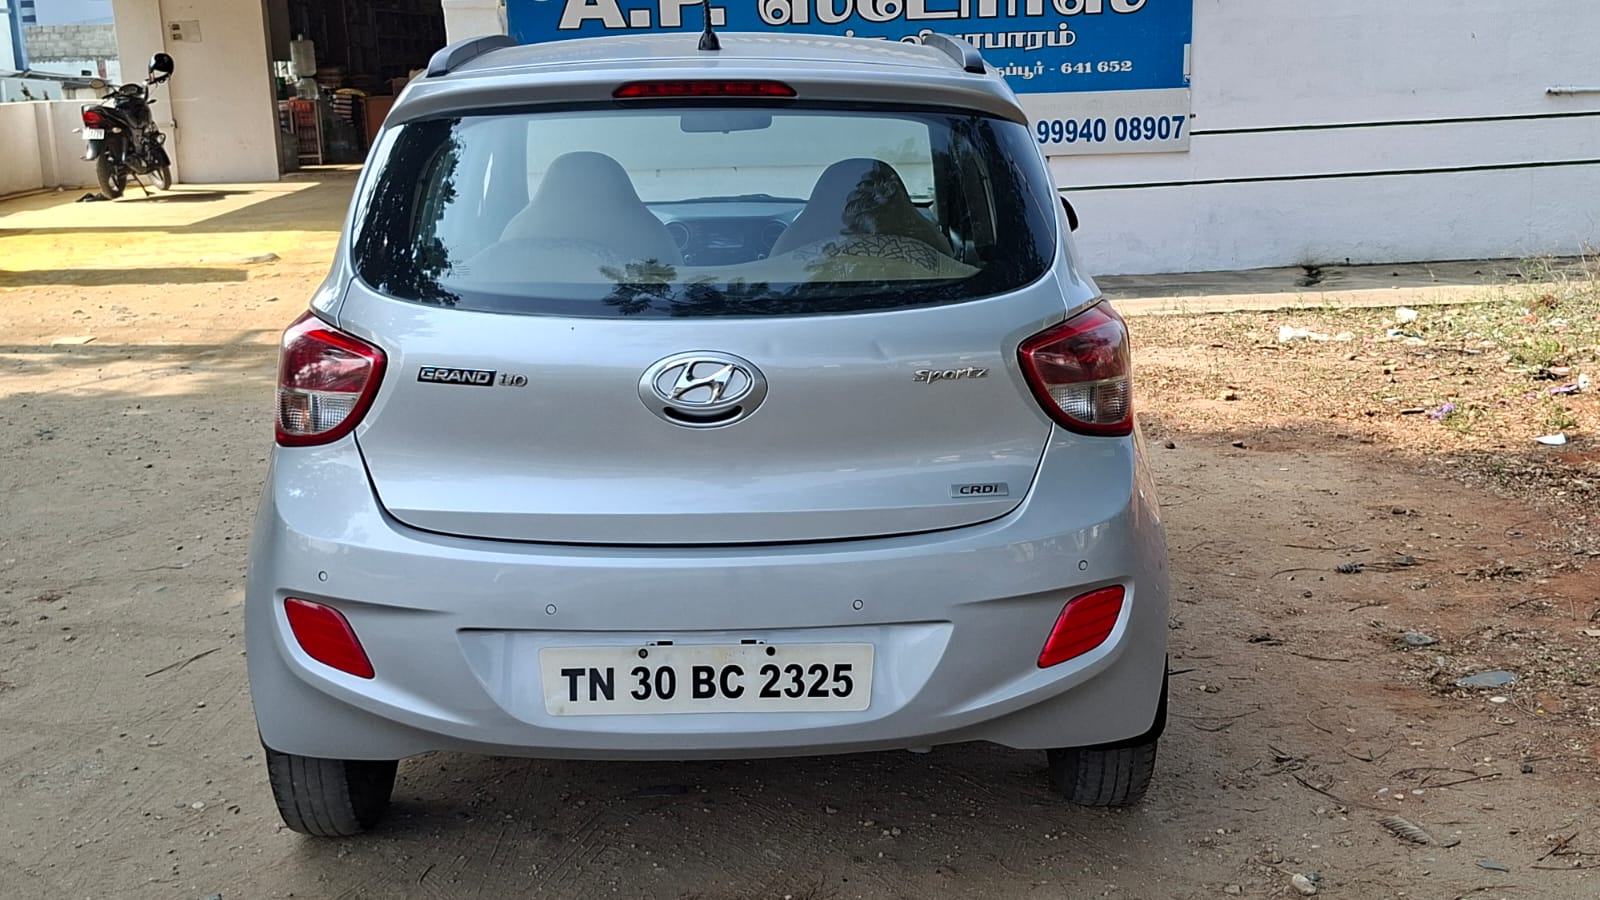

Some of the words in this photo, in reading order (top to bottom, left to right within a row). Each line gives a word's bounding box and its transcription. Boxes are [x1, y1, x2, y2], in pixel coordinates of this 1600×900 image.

[1060, 62, 1092, 74] 641
[1097, 60, 1133, 73] 652
[1036, 118, 1107, 144] 99940
[1113, 115, 1187, 142] 08907
[419, 367, 492, 384] GRAND
[912, 366, 989, 385] Sportz
[959, 484, 999, 495] CRDi
[560, 667, 615, 701] TN
[630, 665, 677, 700] 30
[691, 664, 745, 699] BC
[758, 663, 854, 699] 2325
